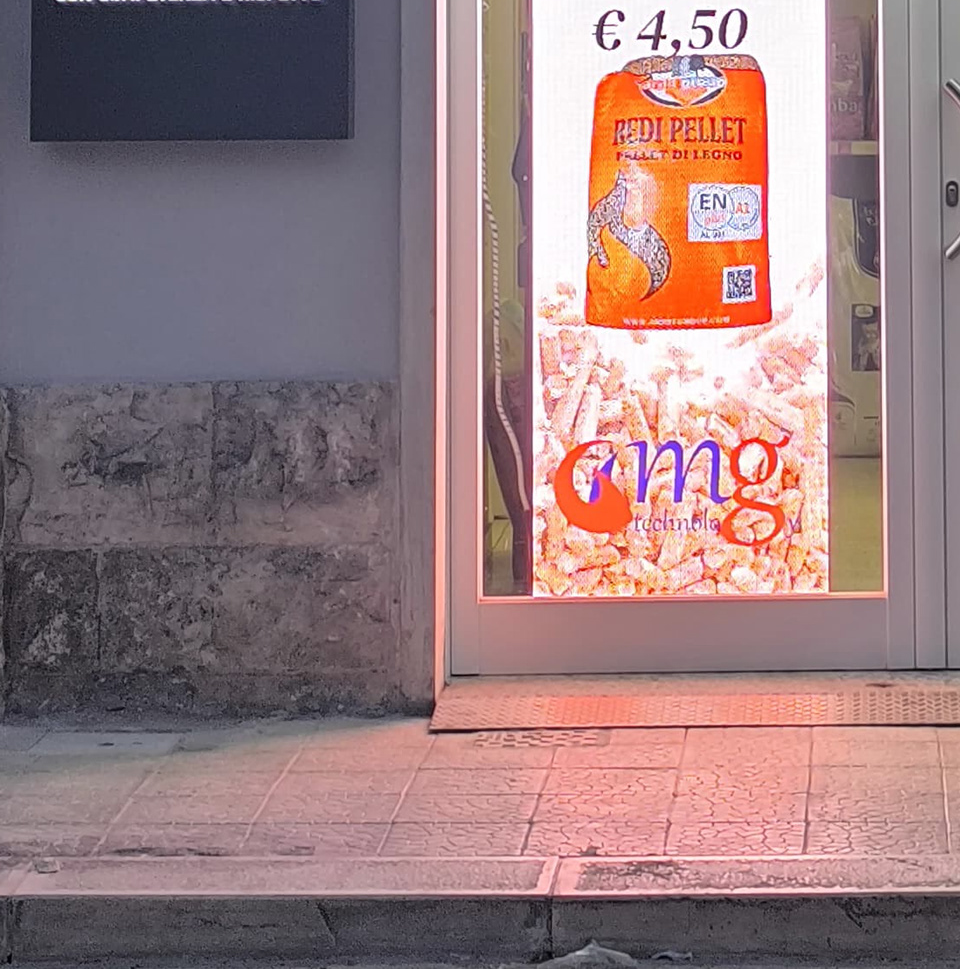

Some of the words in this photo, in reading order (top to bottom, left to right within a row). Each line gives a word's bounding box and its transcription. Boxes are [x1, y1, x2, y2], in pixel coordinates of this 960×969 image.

[592, 9, 625, 51] €
[637, 8, 749, 57] 4,50
[670, 115, 748, 145] PELLET
[672, 149, 688, 161] DI
[692, 149, 743, 161] LEGNO
[700, 193, 727, 211] EN
